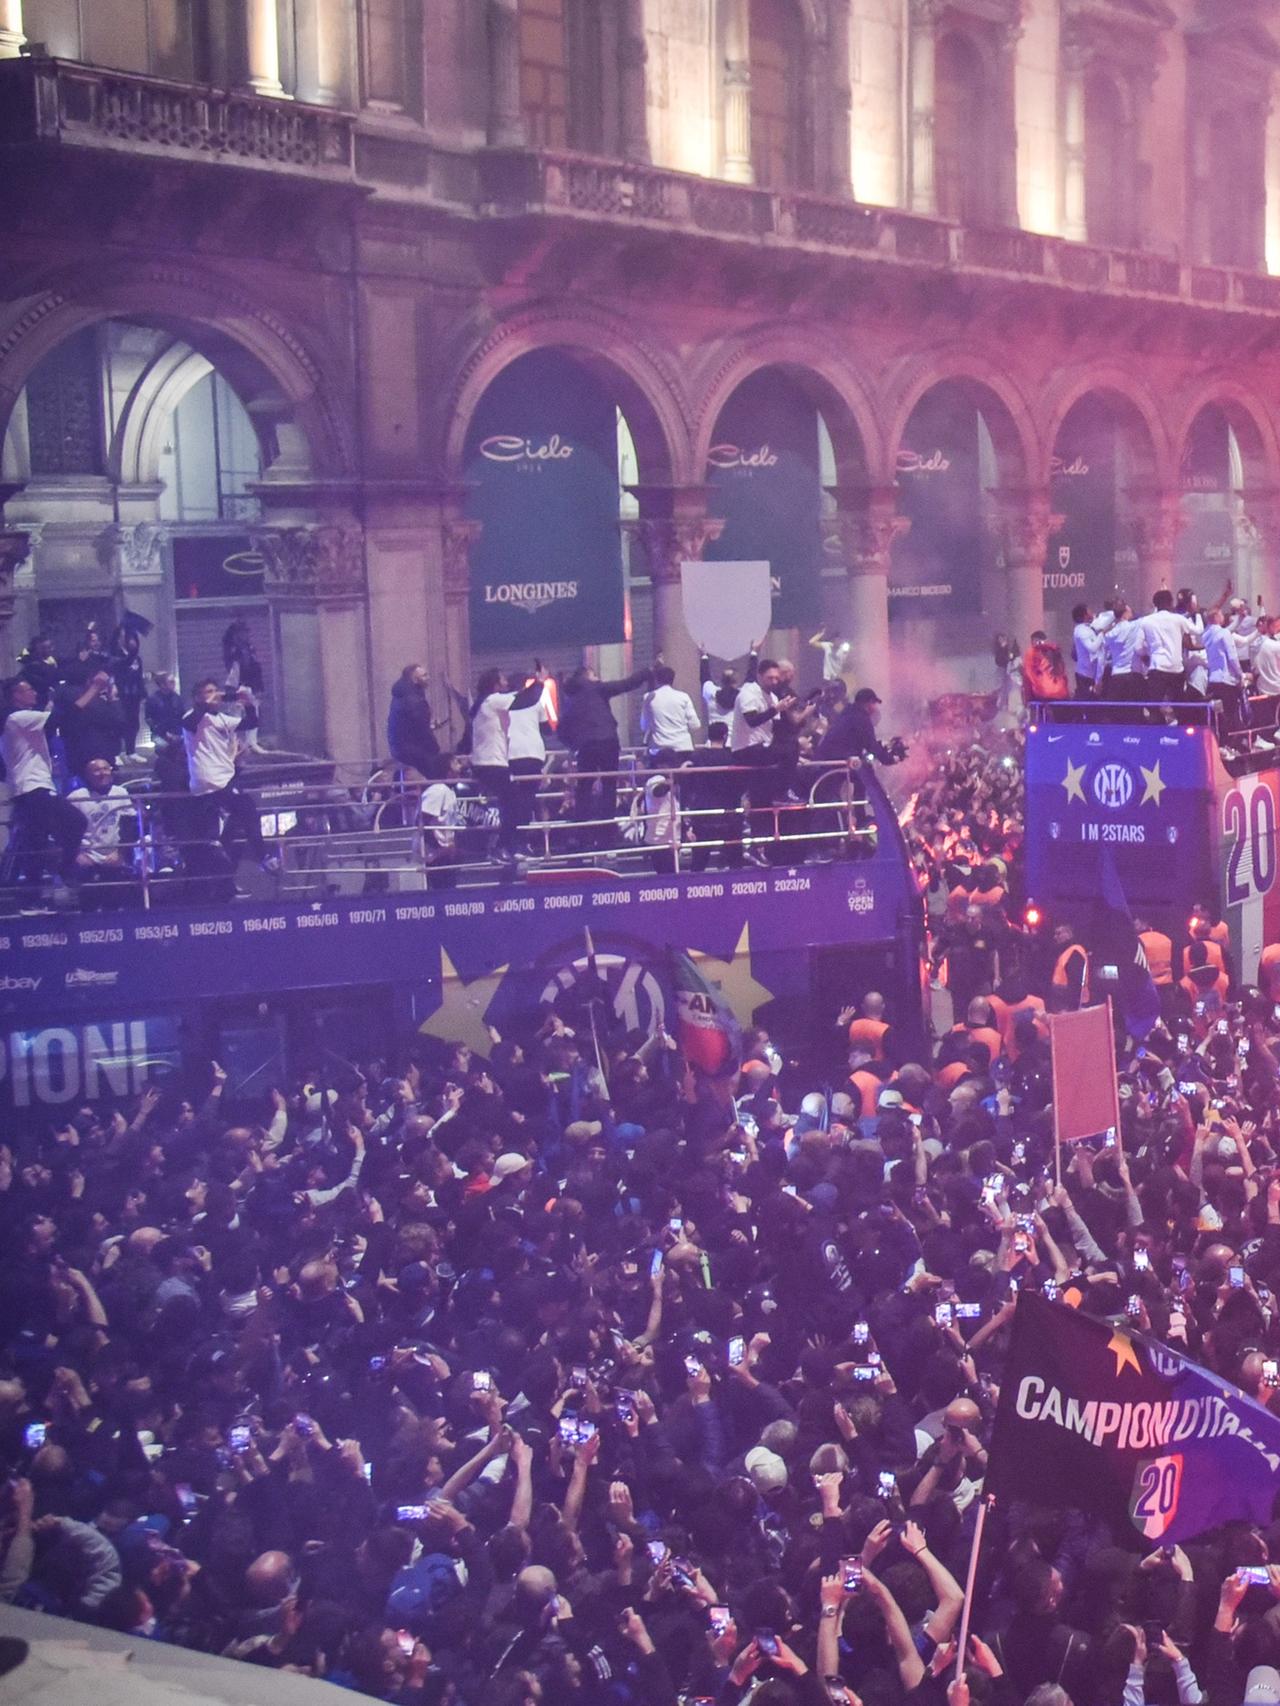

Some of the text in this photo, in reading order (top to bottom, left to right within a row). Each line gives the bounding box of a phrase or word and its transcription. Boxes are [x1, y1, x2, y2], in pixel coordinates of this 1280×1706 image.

[480, 434, 574, 461] Cielo
[708, 444, 779, 468] Cielo
[896, 450, 950, 471] Cielo
[485, 581, 578, 602] LONGINES
[1043, 572, 1085, 588] TUDOR
[1223, 782, 1277, 908] 20
[79, 929, 124, 944] 1952/53
[135, 924, 180, 940] 1953/54
[189, 921, 233, 936] 1962/63
[243, 917, 287, 932] 1964/65
[296, 913, 339, 928] 1965/66
[349, 909, 386, 924] 1970/71
[395, 905, 435, 921] 1979/80
[444, 902, 485, 917] 1988/89
[544, 895, 583, 910] 2006/07
[592, 891, 631, 905] 2007/08
[639, 887, 679, 902] 2008/09
[687, 883, 724, 899] 2009/10
[732, 881, 767, 895] 2020/21
[775, 878, 811, 892] 2023/24
[848, 896, 874, 904] OPEN
[849, 903, 874, 911] TOUR
[0, 1020, 149, 1106] IONI
[1016, 1376, 1179, 1449] CAMPIONI
[1134, 1463, 1177, 1518] 20
